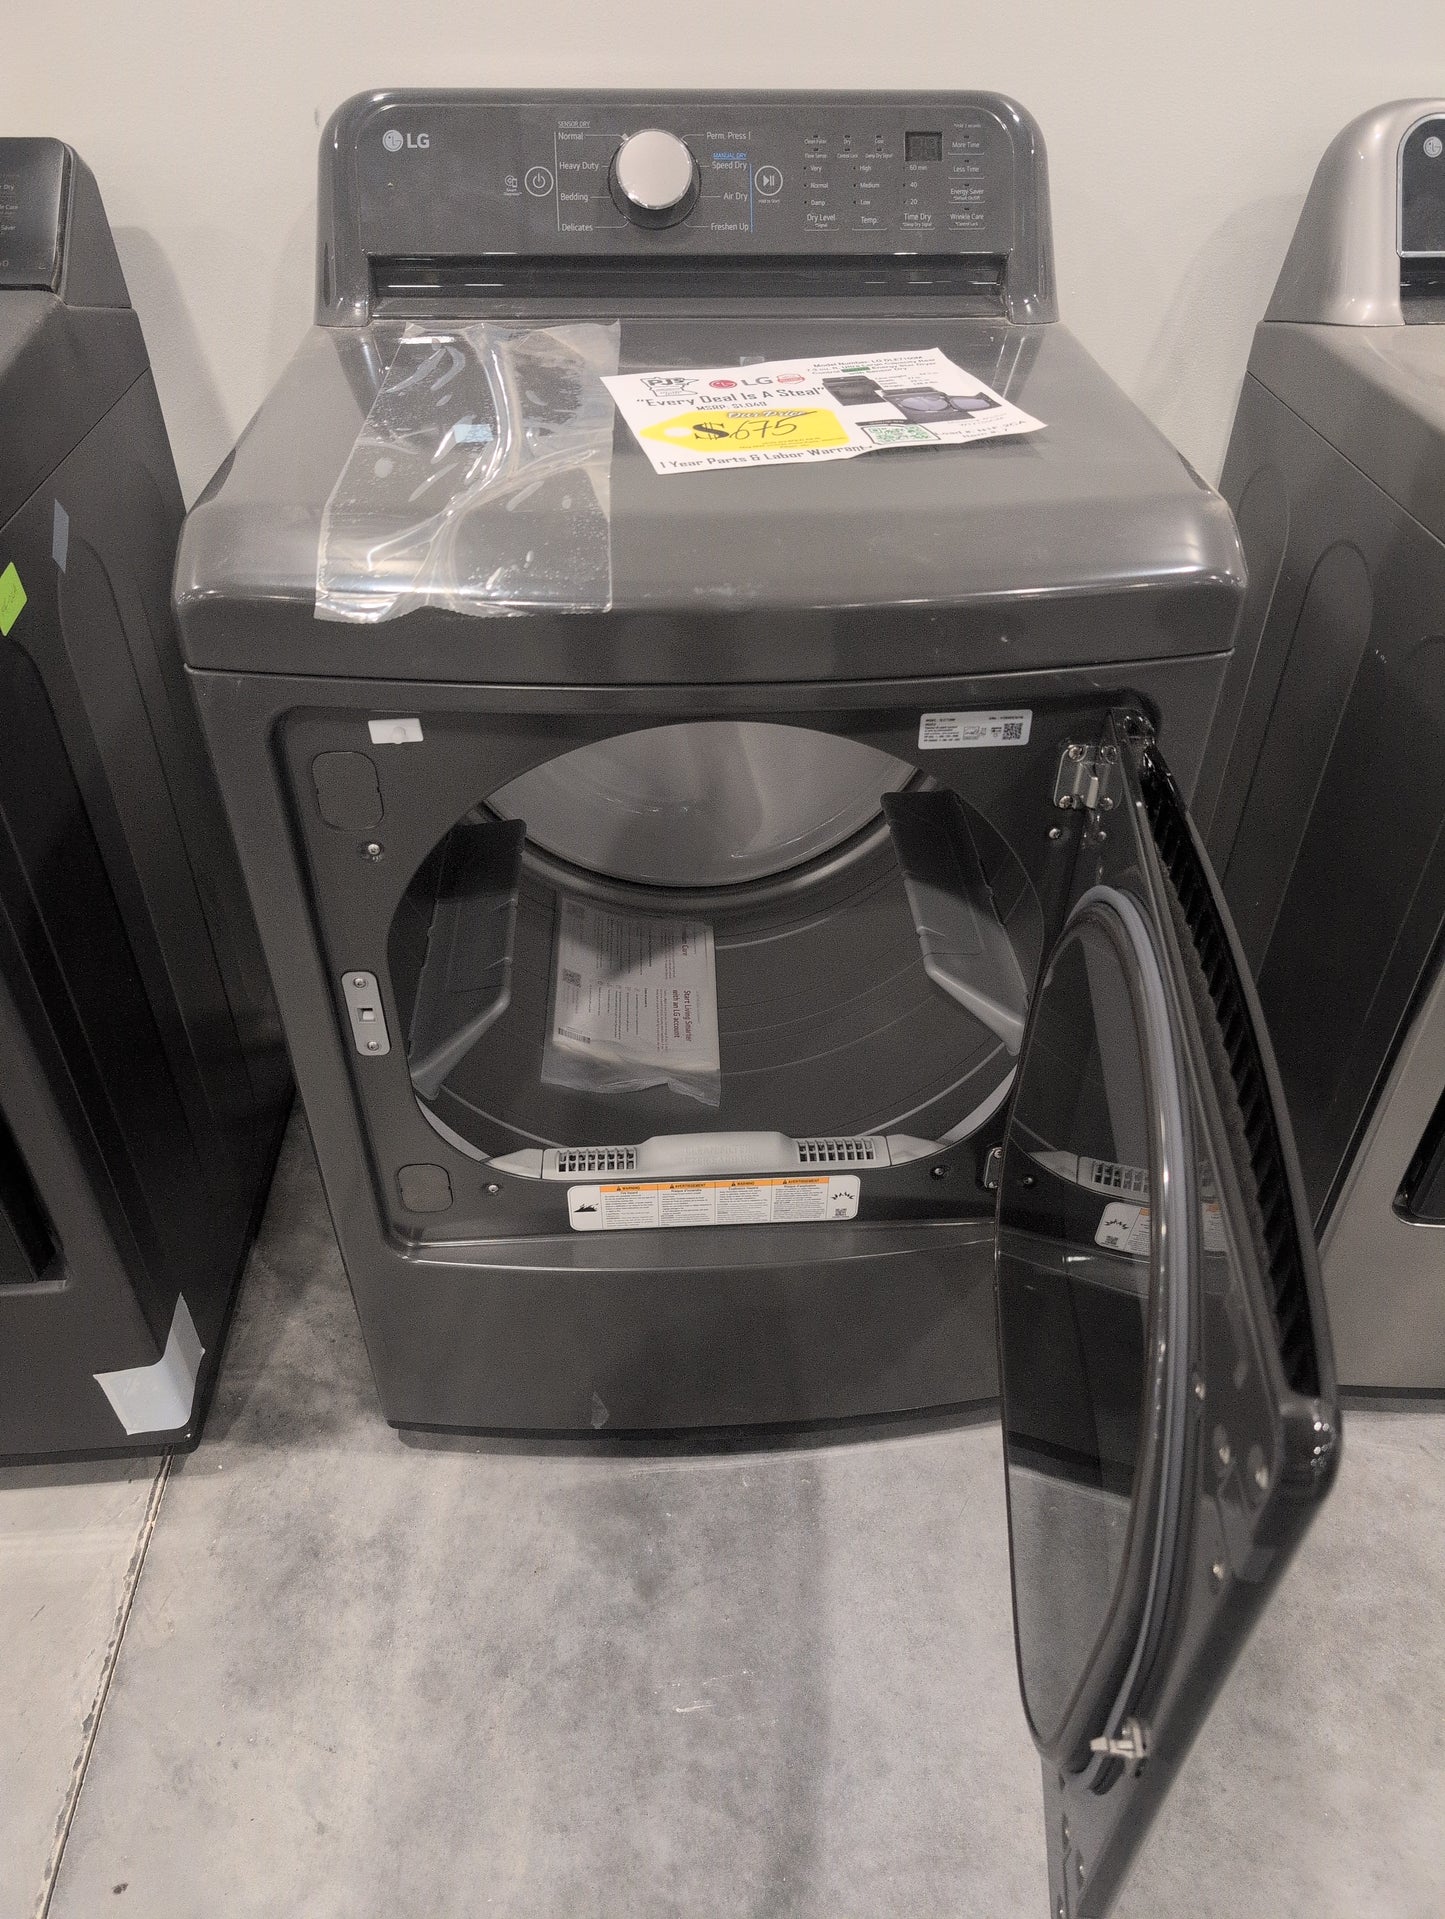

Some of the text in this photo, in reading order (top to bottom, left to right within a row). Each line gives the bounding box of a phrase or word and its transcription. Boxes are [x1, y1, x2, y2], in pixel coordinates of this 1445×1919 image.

[580, 120, 591, 128] DRY
[558, 132, 584, 140] Normal
[706, 131, 747, 140] Perm. Press
[407, 133, 430, 149] LG
[559, 161, 600, 171] Heavy Duty
[711, 161, 748, 171] Speed Dry
[723, 192, 748, 201] Air Dry
[950, 188, 968, 196] Energy
[560, 193, 589, 202] Bedding
[806, 213, 836, 223] Dry Level
[861, 216, 879, 225] Temp.
[920, 213, 932, 222] Dry
[561, 223, 594, 232] Delicates
[710, 223, 749, 232] Freshen Up
[742, 377, 773, 386] LG
[699, 393, 737, 404] Deal
[741, 391, 756, 400] Is
[763, 389, 773, 398] A
[660, 461, 665, 469] 1
[667, 459, 703, 468] Year
[707, 455, 746, 465] Parts
[763, 451, 804, 460] Labor
[672, 989, 680, 1001] with
[673, 1001, 678, 1009] an
[673, 1009, 680, 1017] LG
[682, 990, 693, 1042] Start Living Smarter
